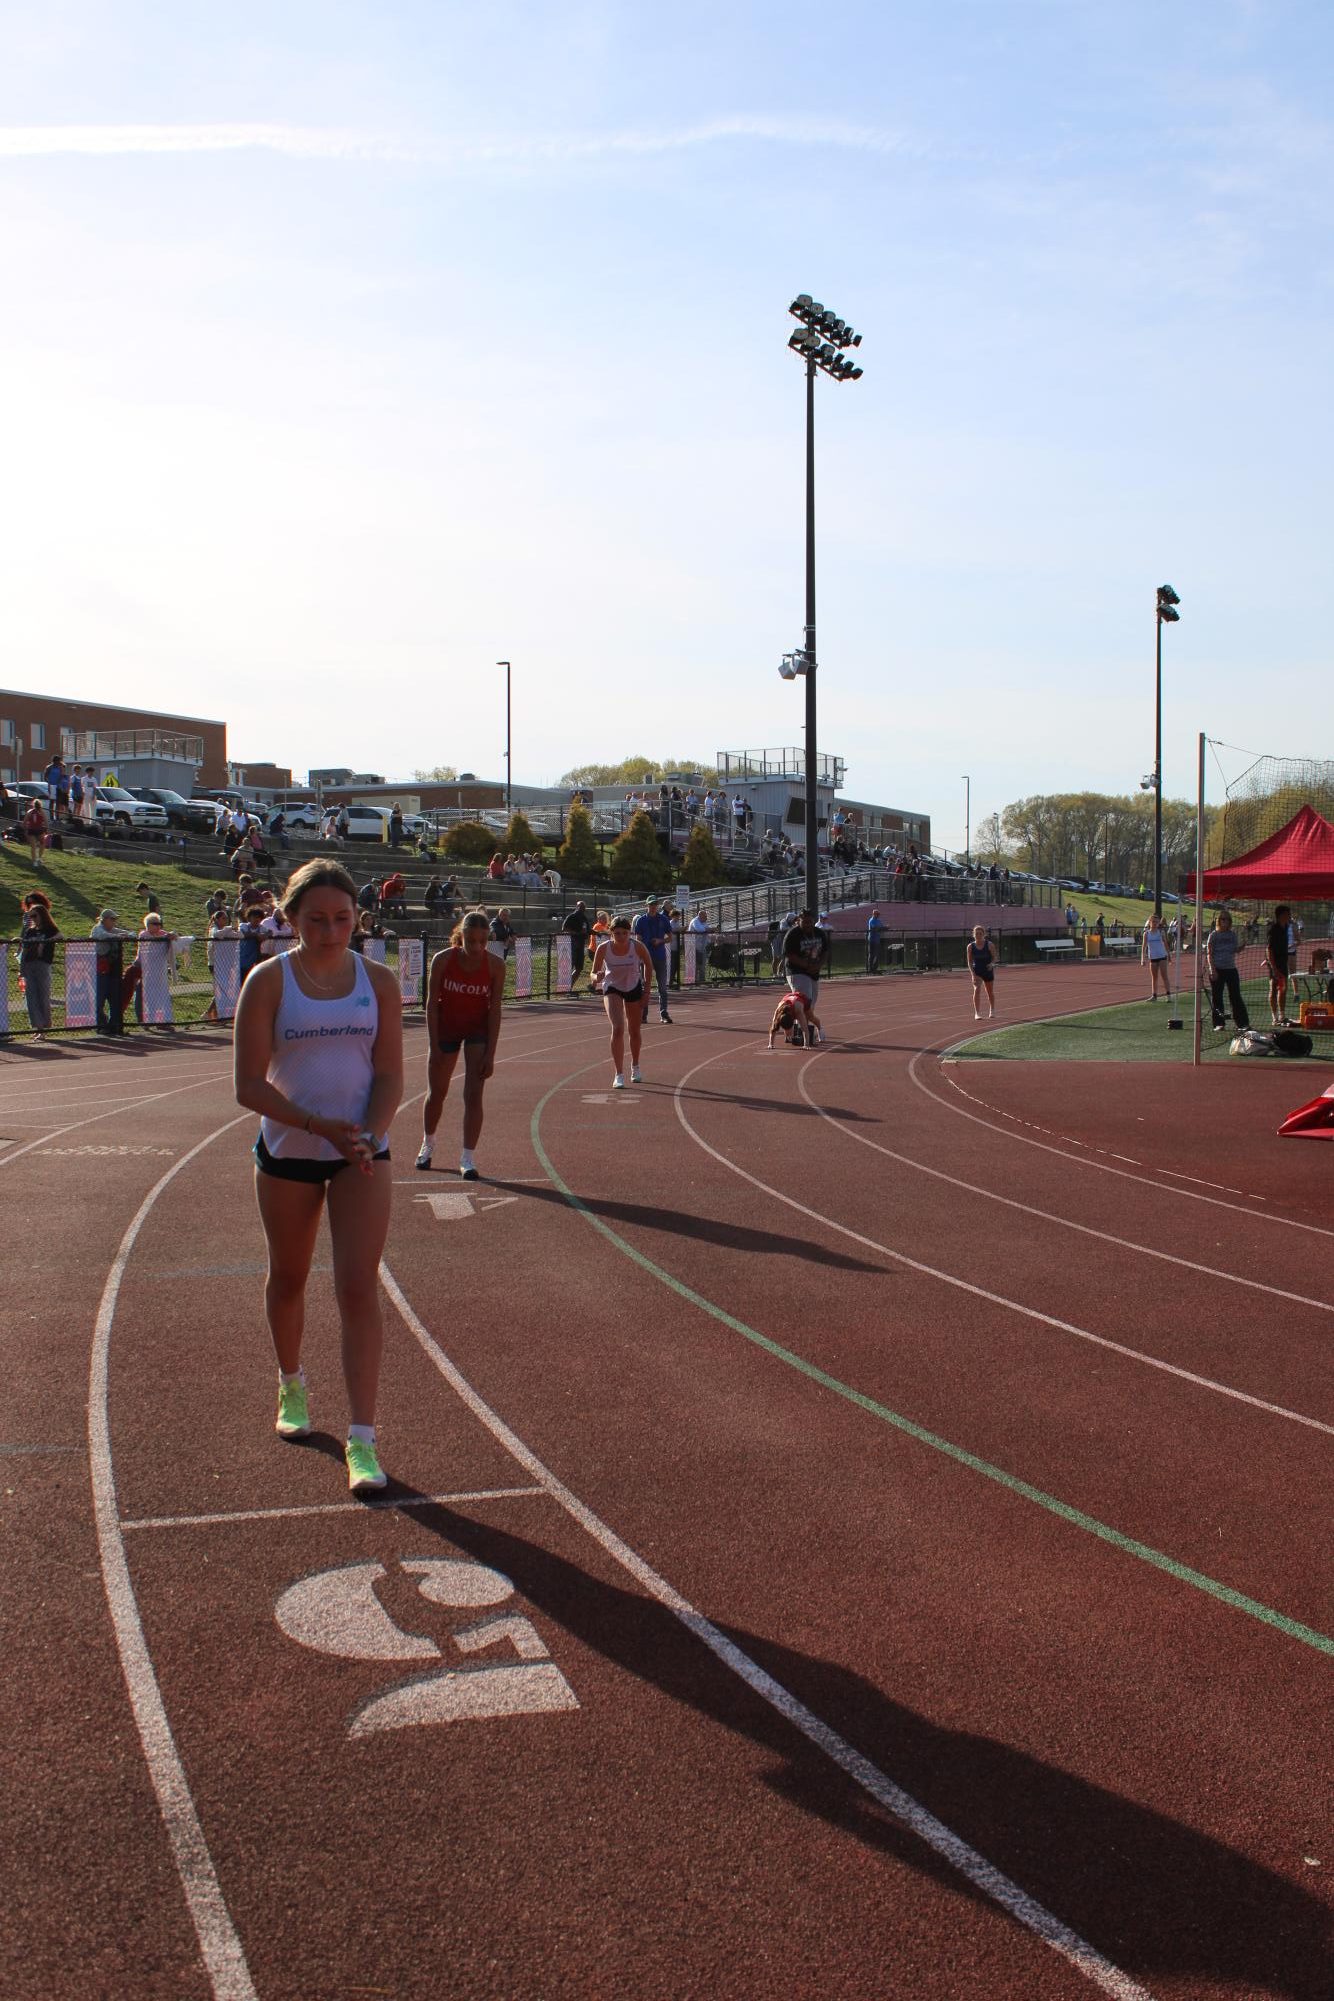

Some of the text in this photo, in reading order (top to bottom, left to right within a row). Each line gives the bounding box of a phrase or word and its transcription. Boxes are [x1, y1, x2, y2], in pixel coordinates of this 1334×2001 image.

[443, 978, 489, 995] LINCOLN
[284, 1025, 375, 1041] Cumberland
[274, 1557, 582, 1742] 5
